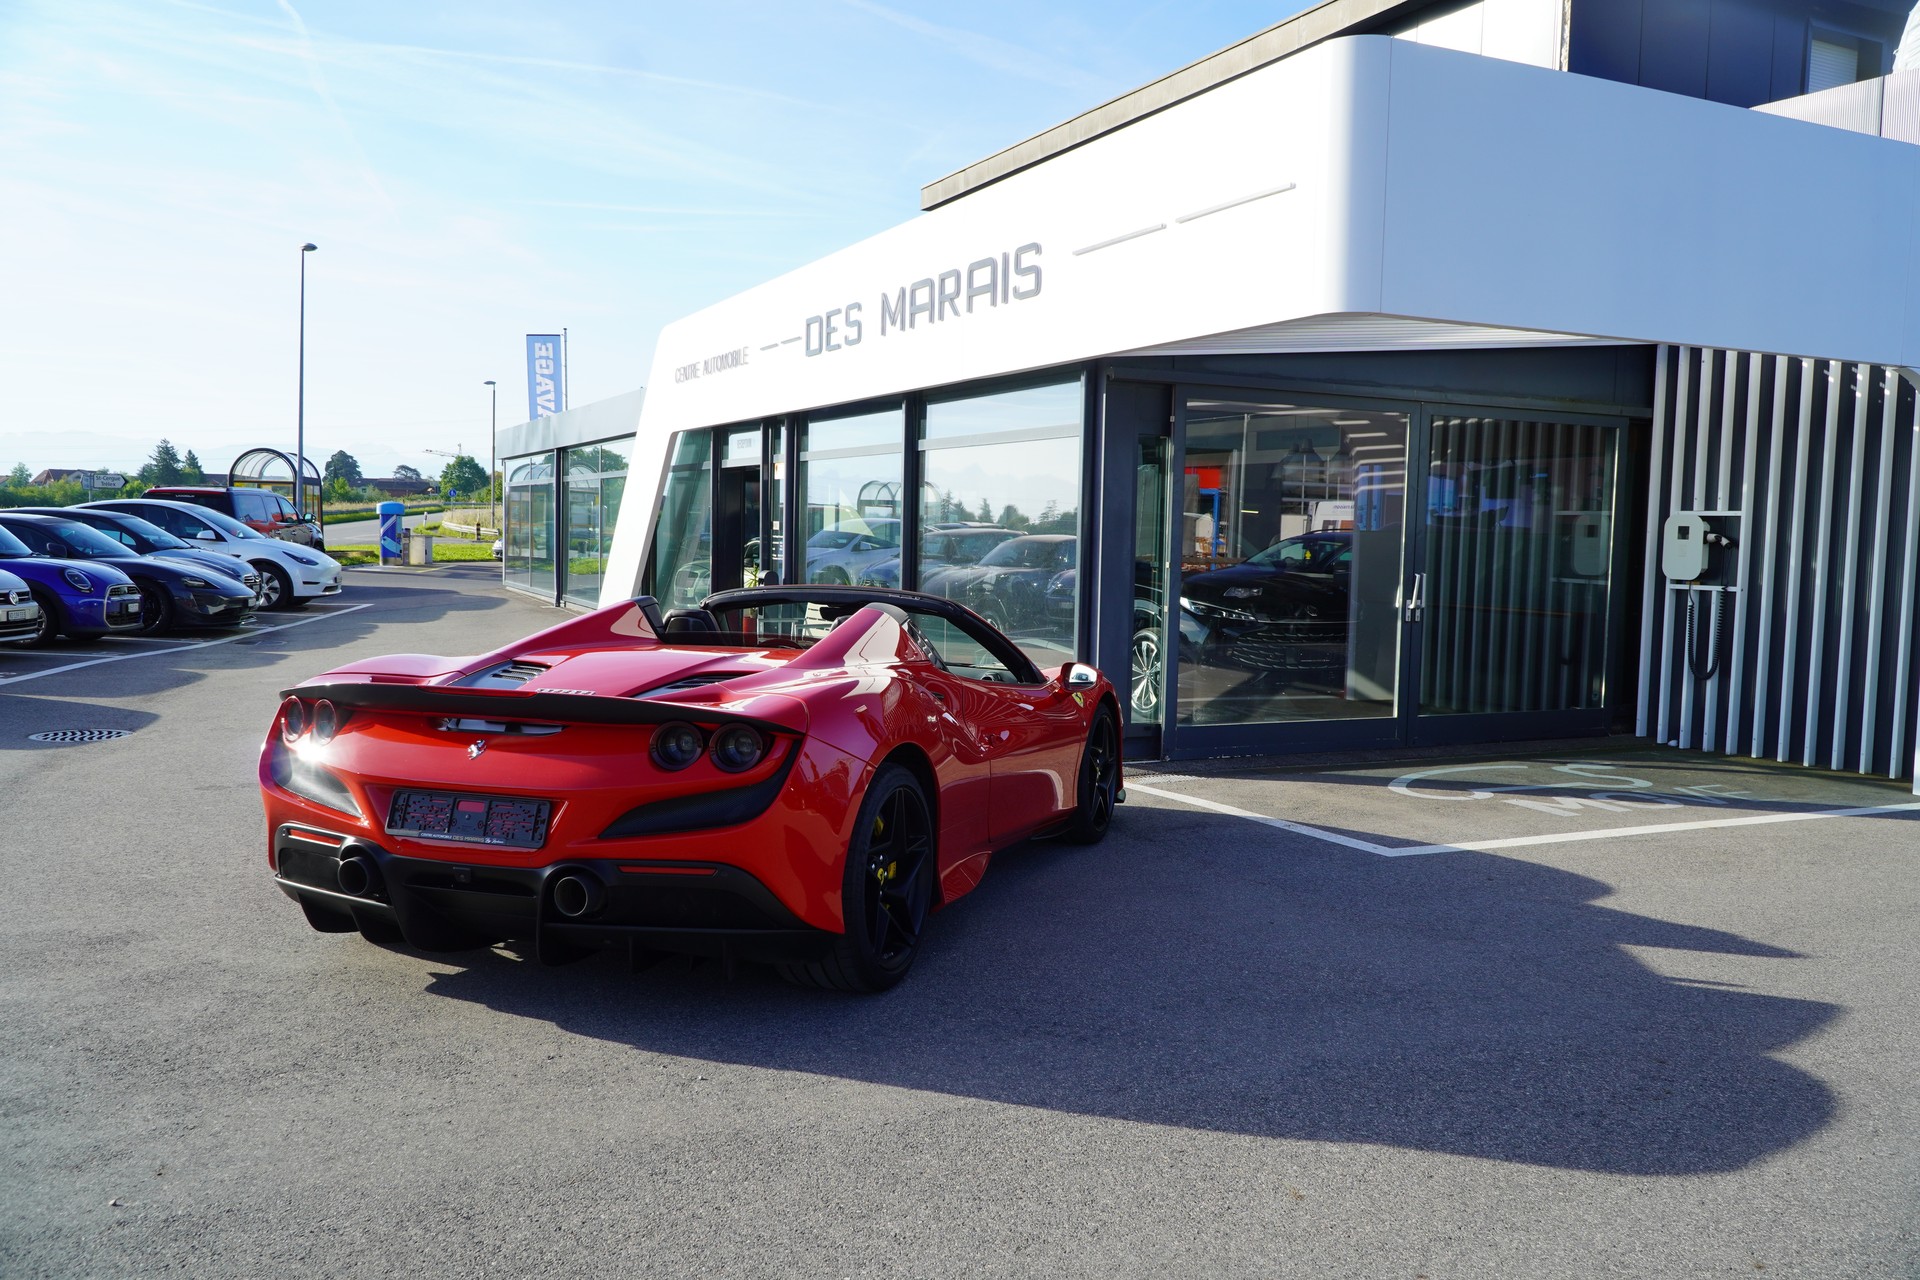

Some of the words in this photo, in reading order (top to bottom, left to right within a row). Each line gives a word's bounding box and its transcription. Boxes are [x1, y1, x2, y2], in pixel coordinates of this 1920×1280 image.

[675, 361, 701, 384] CENTRE
[703, 346, 749, 376] AUTOMOBILE
[805, 302, 863, 357] DES
[880, 242, 1042, 337] MARAIS
